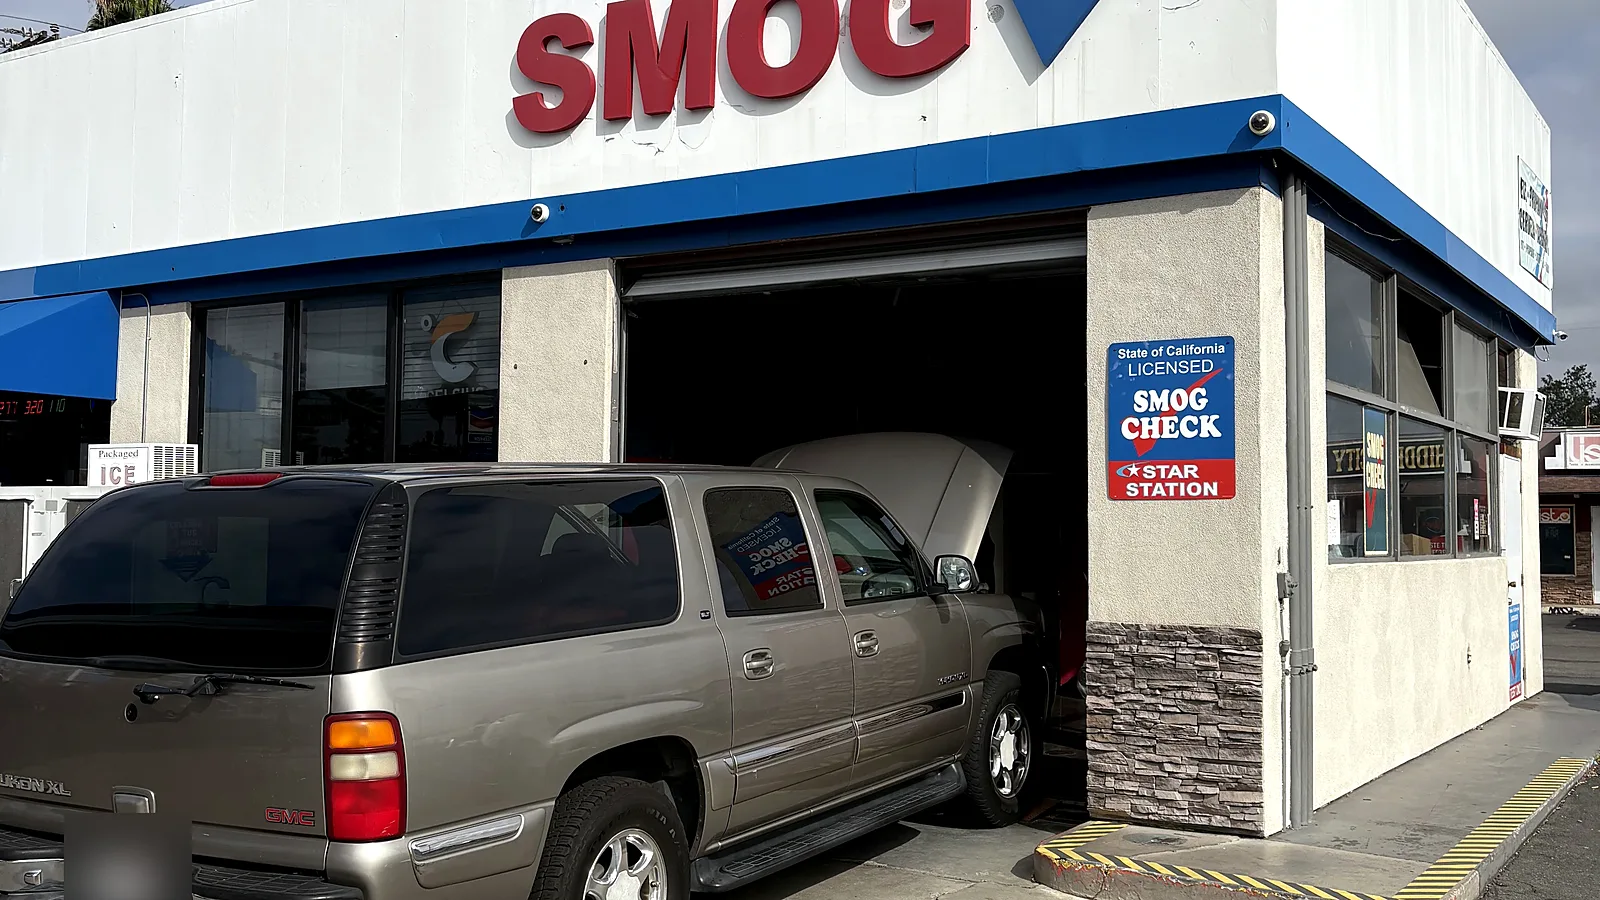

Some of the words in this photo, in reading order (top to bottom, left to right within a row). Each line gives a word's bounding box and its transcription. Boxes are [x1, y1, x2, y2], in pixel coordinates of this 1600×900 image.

[512, 0, 971, 134] SMOG
[1117, 347, 1148, 360] State
[1151, 346, 1164, 358] of
[1166, 342, 1225, 357] California
[1128, 359, 1214, 377] LICENSED
[1133, 387, 1209, 413] SMOG
[1121, 414, 1222, 440] CHECK
[98, 450, 139, 459] Packaged
[101, 464, 136, 487] ICE
[1142, 464, 1200, 479] STAR
[1126, 481, 1218, 497] STATION
[46, 780, 72, 797] XL
[265, 807, 314, 826] GMC
